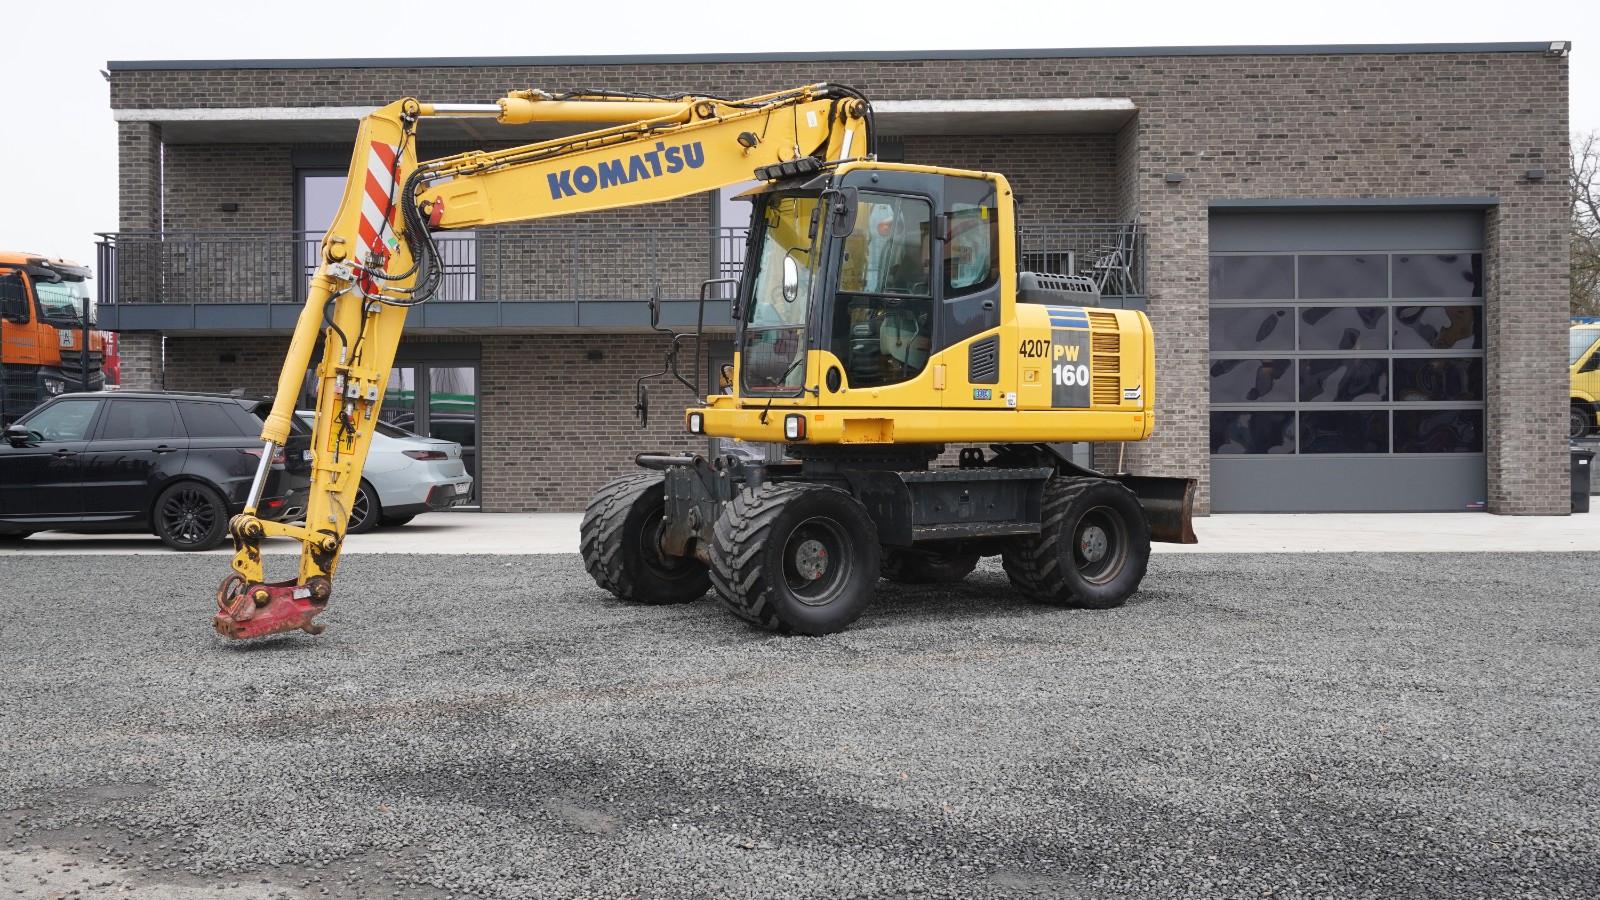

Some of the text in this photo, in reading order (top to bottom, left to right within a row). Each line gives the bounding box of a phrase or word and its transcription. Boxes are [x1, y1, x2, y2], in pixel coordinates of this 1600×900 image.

[547, 141, 704, 200] KOMATSU
[1019, 339, 1051, 358] 4207
[1053, 344, 1080, 362] PW
[1053, 364, 1089, 387] 160
